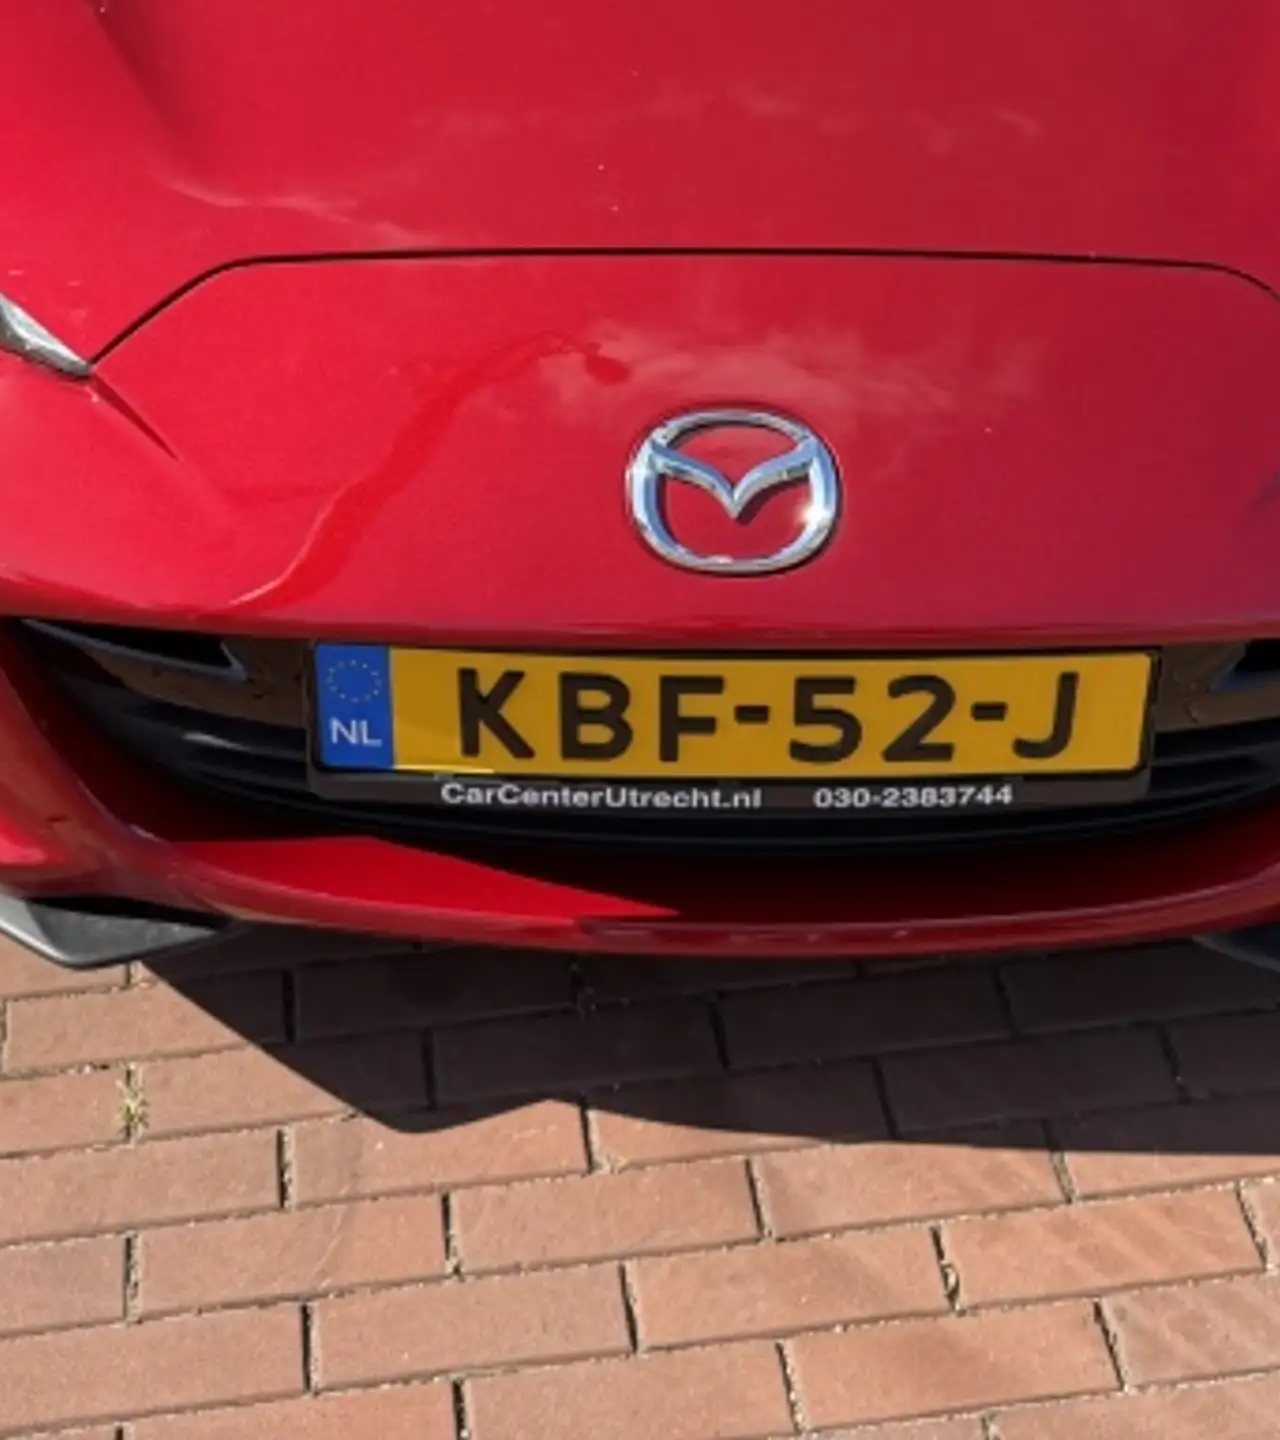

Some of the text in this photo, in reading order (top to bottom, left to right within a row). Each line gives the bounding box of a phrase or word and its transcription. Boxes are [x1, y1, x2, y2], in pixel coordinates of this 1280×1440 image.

[458, 667, 1079, 764] KBF-52-J
[330, 717, 382, 748] NL
[441, 782, 1013, 809] CarCenterUtrecht.nl 030-2383744
